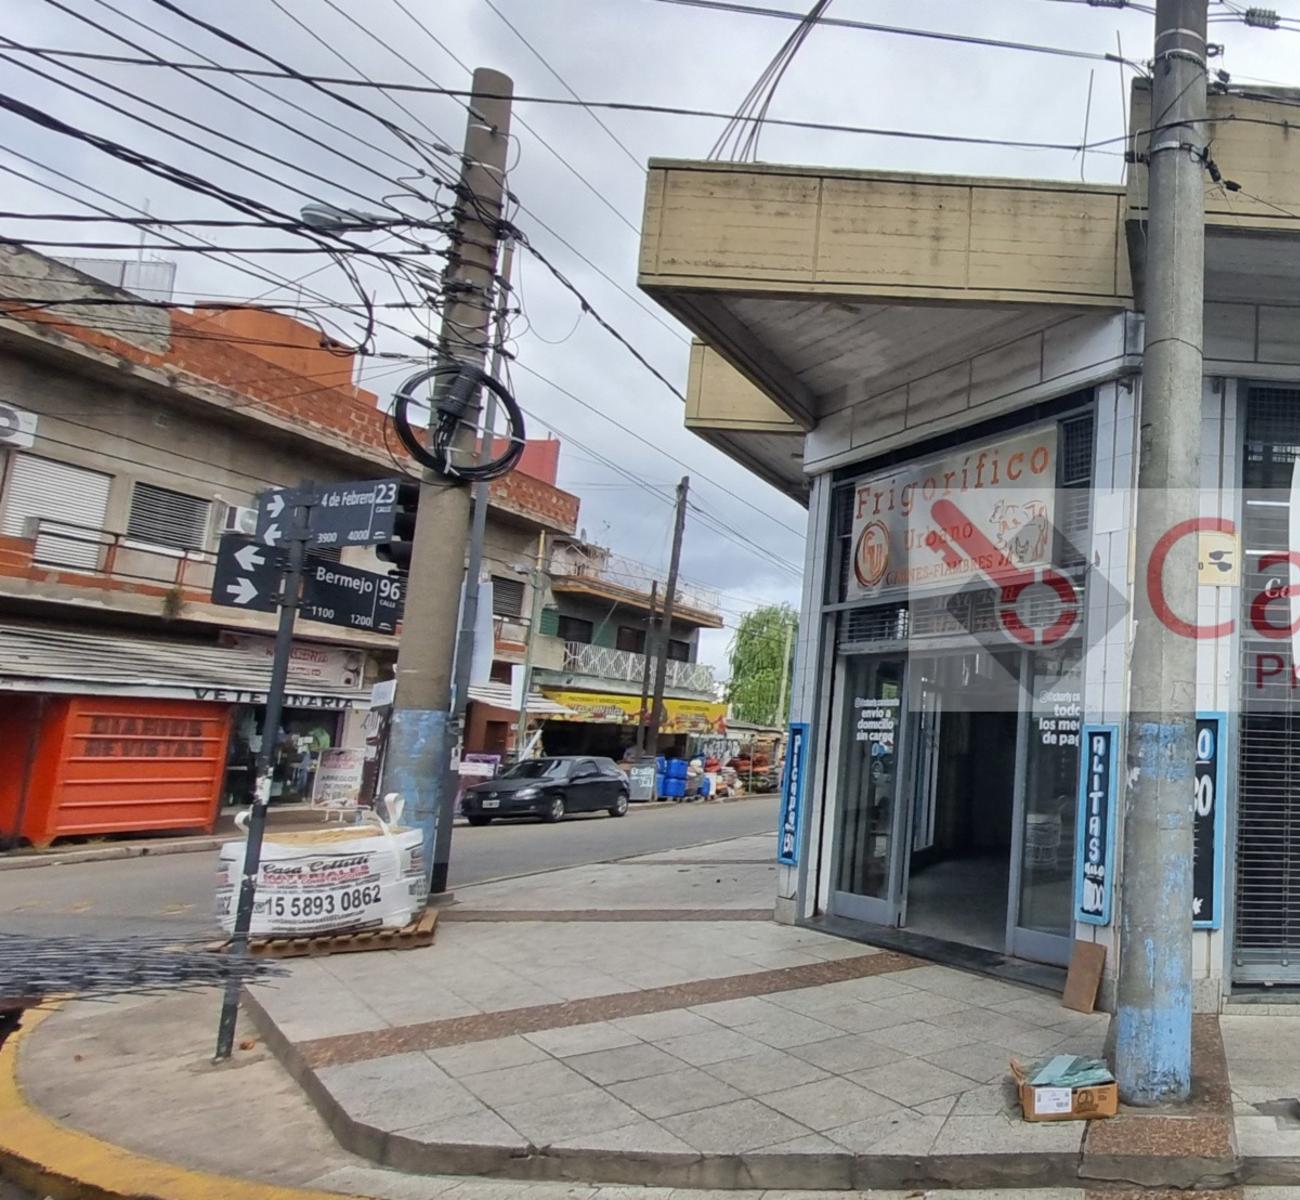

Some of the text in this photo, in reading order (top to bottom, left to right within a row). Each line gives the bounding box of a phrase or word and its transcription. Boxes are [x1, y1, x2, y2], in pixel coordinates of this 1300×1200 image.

[856, 445, 1049, 519] Frigorífico
[321, 490, 374, 507] 4 de Febrero
[375, 483, 397, 504] 23
[375, 505, 392, 513] CALLE
[316, 532, 338, 544] 3900
[347, 529, 369, 541] 4000
[904, 521, 974, 550] Urbano
[315, 565, 373, 595] Bermejo
[379, 579, 400, 600] 96
[311, 606, 335, 619] 1100
[379, 599, 396, 609] CALLE
[350, 613, 372, 627] 1200
[193, 687, 354, 709] VETEINARIA
[1039, 717, 1056, 730] los
[1042, 731, 1057, 744] de
[1088, 735, 1106, 863] ALITAS
[290, 894, 335, 917] 5893
[340, 884, 382, 911] 0862
